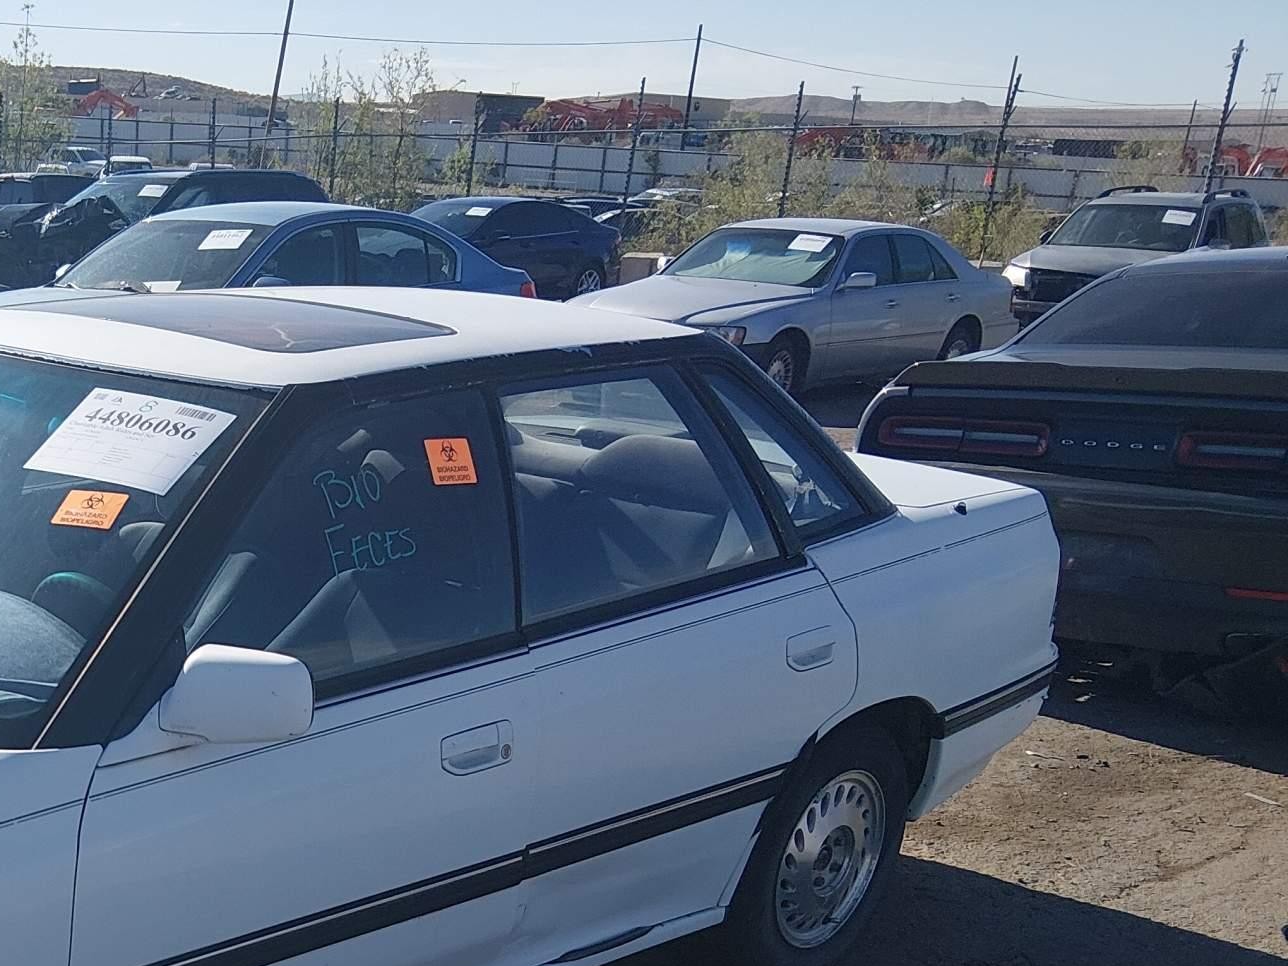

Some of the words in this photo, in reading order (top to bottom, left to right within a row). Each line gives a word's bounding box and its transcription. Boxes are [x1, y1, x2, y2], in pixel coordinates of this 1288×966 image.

[84, 407, 201, 441] 44806086
[1061, 439, 1166, 451] DODGE
[312, 469, 380, 519] BIO
[324, 523, 417, 578] FECES
